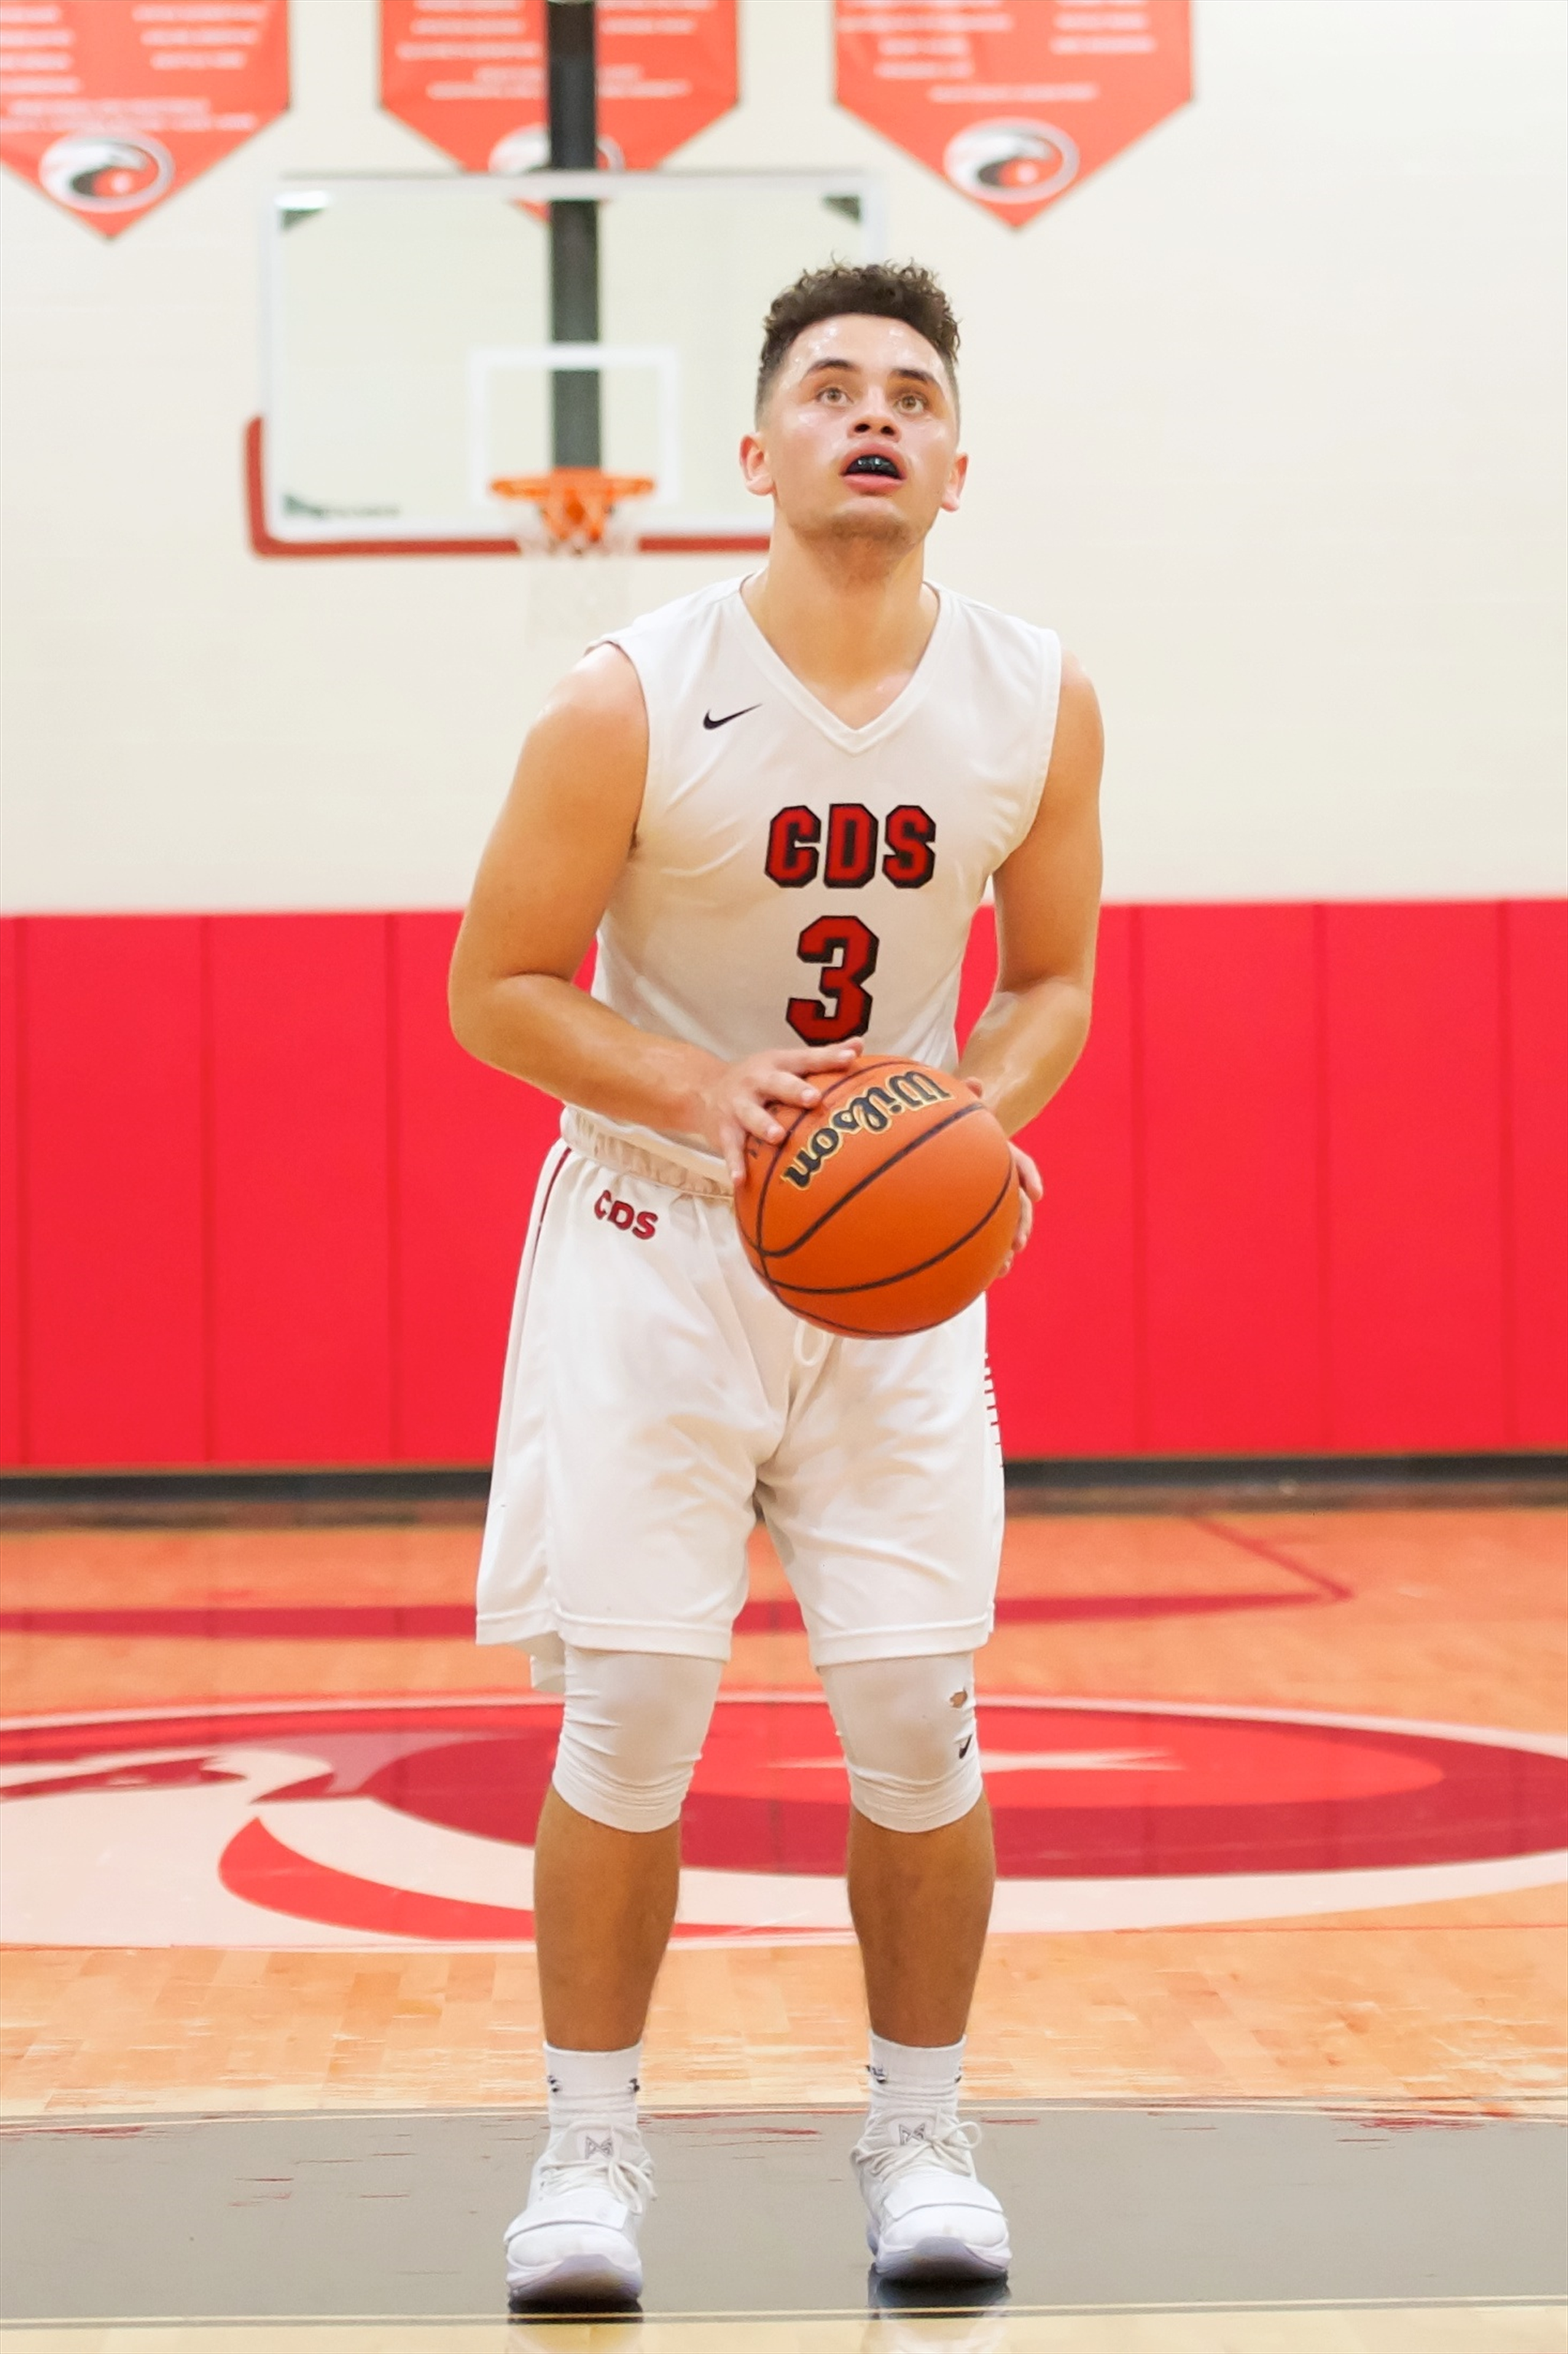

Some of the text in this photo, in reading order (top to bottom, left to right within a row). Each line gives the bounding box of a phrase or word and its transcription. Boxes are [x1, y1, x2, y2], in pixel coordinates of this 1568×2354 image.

[764, 803, 936, 888] CDS
[786, 915, 879, 1046] 3
[781, 1071, 954, 1190] Wilson
[594, 1189, 658, 1240] CDS
